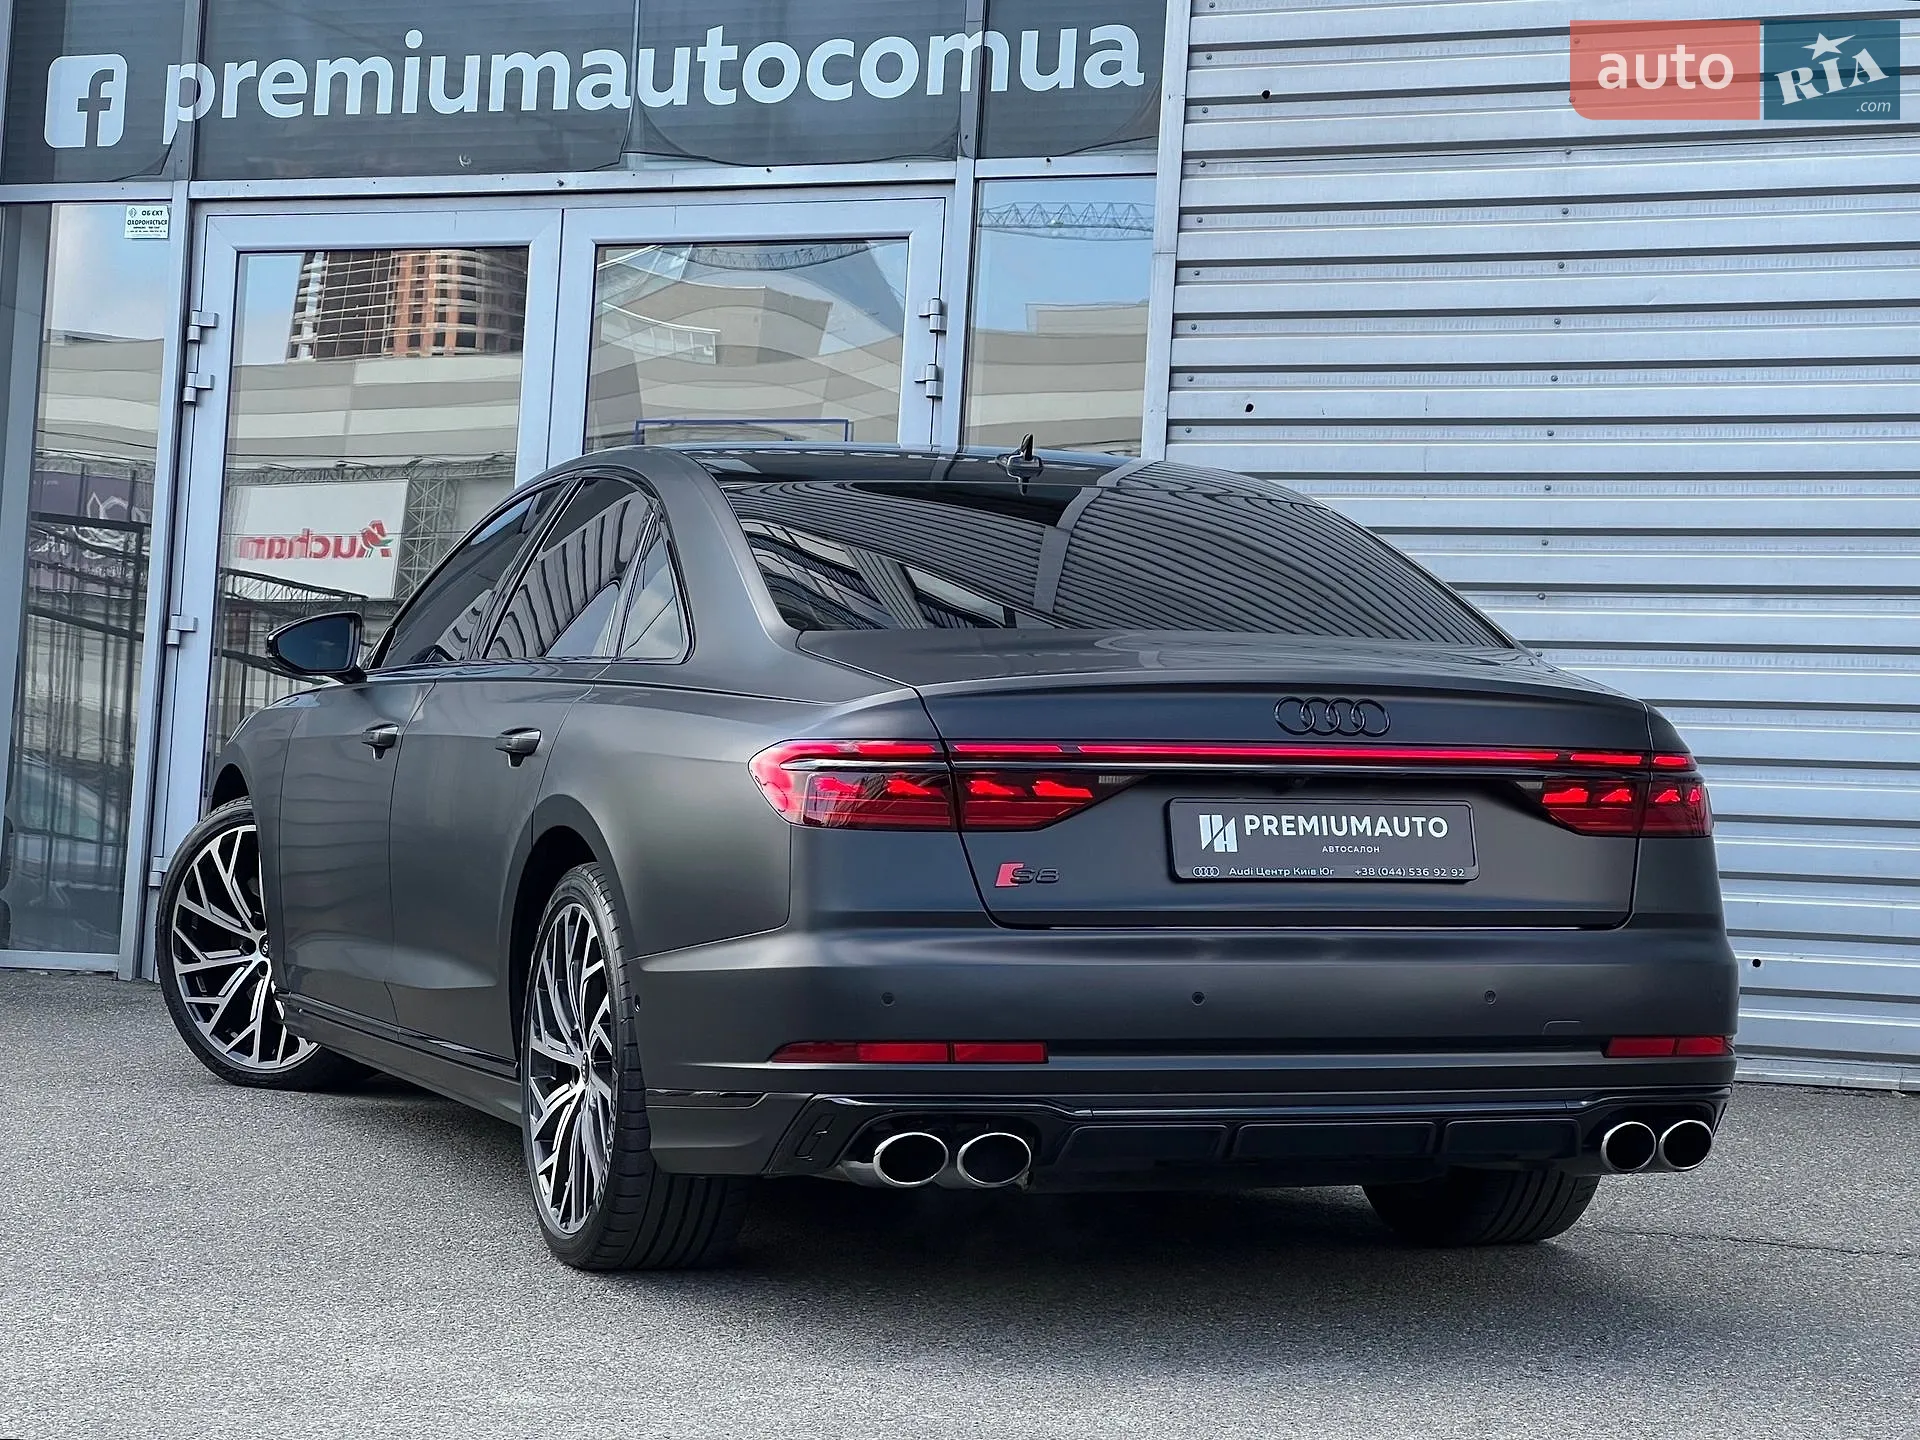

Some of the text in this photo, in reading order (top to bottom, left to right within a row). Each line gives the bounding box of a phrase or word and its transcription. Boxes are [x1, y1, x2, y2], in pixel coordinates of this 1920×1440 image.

[163, 23, 1144, 145] premiumautocomua
[1243, 813, 1449, 839] PREMIUMAUTO
[1321, 844, 1381, 854] АВТОСАЛОН
[1010, 867, 1060, 884] S8
[1228, 866, 1465, 878] Audi Центр Київ Юг +38 (044) 536 92 92
